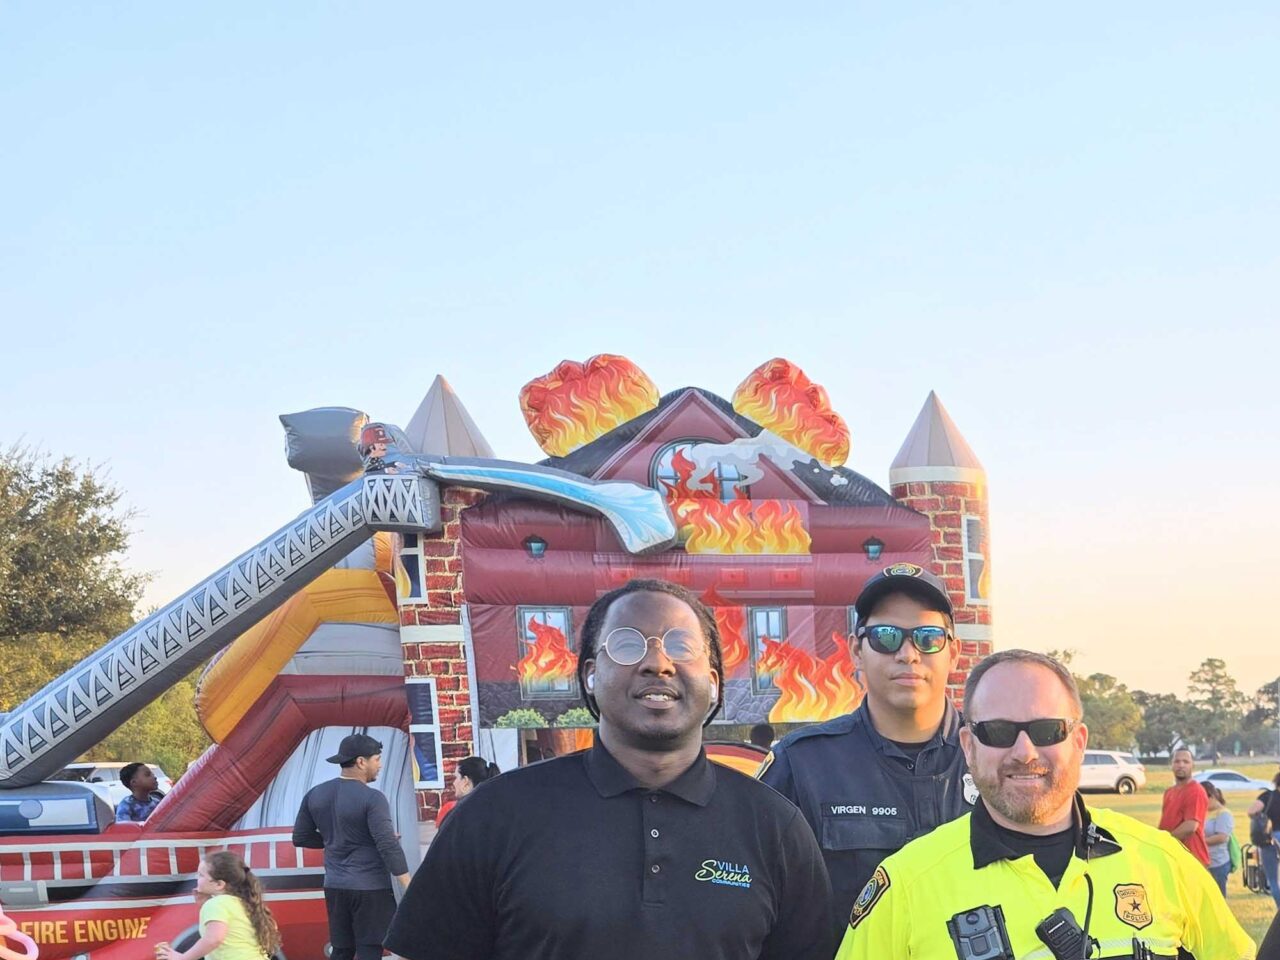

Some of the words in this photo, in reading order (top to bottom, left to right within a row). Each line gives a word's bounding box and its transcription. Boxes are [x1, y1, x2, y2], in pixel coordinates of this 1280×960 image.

[831, 805, 866, 815] VIRGEN
[872, 807, 897, 816] 9905
[695, 859, 752, 883] Serena
[717, 861, 750, 873] VILLA
[21, 920, 69, 944] FIRE
[74, 917, 151, 943] ENGINE
